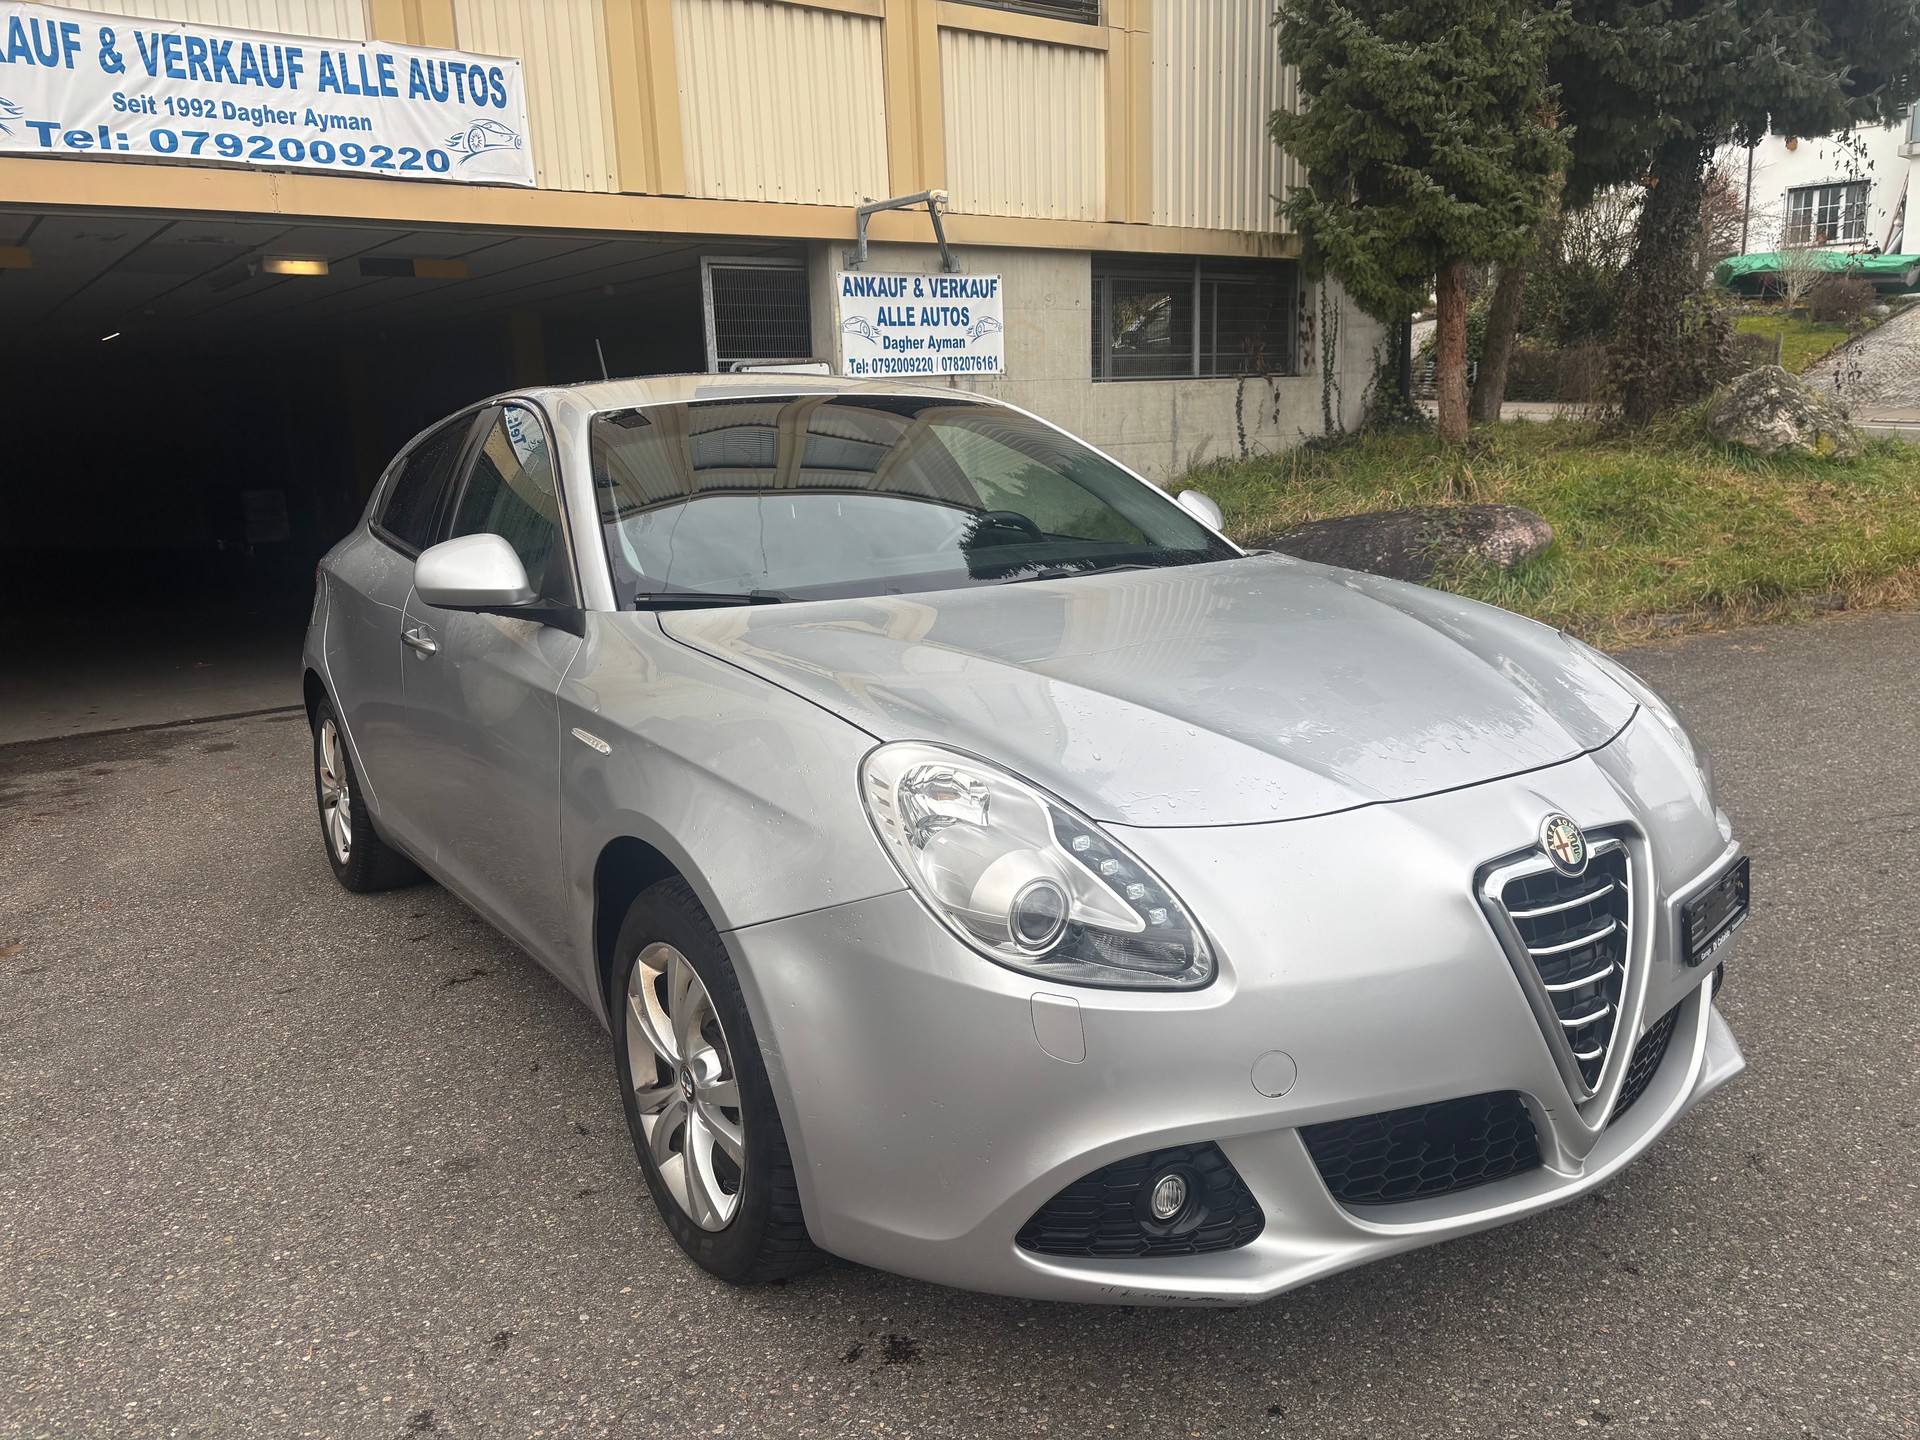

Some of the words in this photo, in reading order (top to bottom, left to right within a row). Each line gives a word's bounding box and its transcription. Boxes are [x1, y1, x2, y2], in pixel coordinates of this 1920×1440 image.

[0, 15, 82, 70] AUF
[98, 26, 126, 75] &
[133, 30, 304, 90] VERKAUF
[318, 50, 399, 98] ALLE
[408, 57, 508, 109] AUTOS
[112, 92, 158, 115] Seit
[164, 96, 218, 119] 1992
[222, 101, 297, 128] Dagher
[304, 107, 372, 133] Ayman
[25, 120, 130, 151] Tel:
[148, 128, 451, 174] 0792009220
[843, 276, 908, 298] ANKAUF
[913, 278, 925, 299] &
[929, 278, 998, 299] VERKAUF
[876, 306, 916, 327] ALLE
[920, 306, 971, 327] AUTOS
[883, 335, 925, 353] Dagher
[928, 335, 966, 352] Ayman
[849, 358, 868, 374] Tel:
[872, 357, 933, 374] 0792009220
[941, 355, 998, 372] 0782076161
[1548, 824, 1557, 850] ALFA
